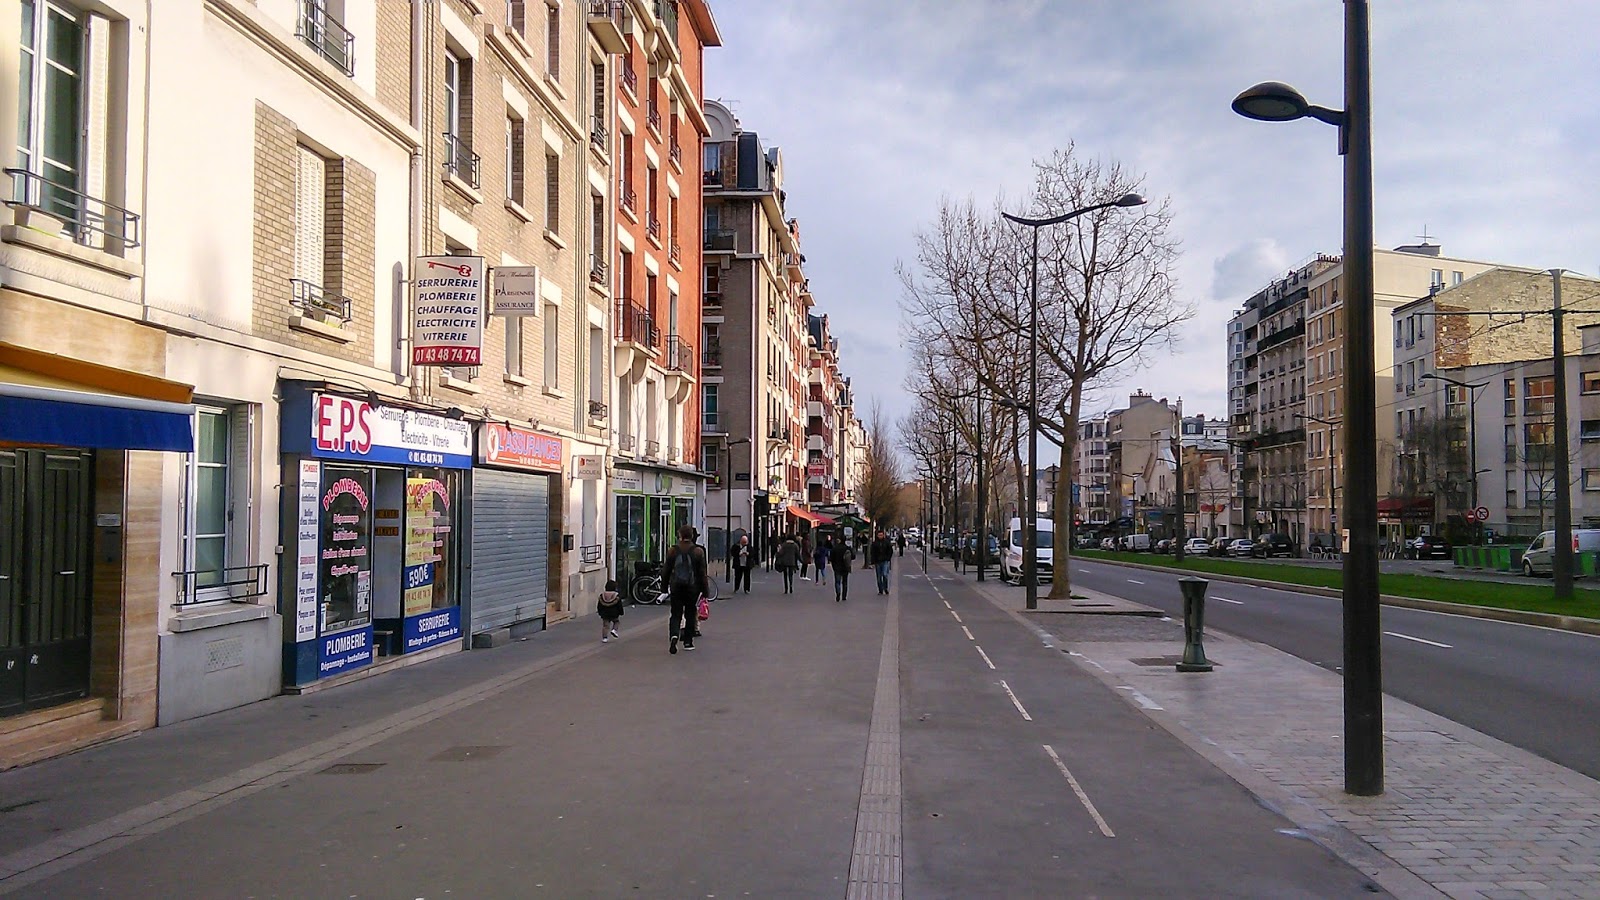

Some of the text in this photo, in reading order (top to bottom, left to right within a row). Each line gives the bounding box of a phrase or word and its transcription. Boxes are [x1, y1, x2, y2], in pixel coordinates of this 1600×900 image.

[418, 279, 478, 288] SERRURERIE
[419, 292, 477, 301] PLOMBERIE
[417, 306, 478, 315] CHAUFFAGE
[416, 319, 477, 328] ELECTRICITE
[422, 332, 468, 341] VITRERIE
[415, 349, 477, 361] 01 43 48 74 74
[318, 396, 371, 453] E.P.S
[414, 411, 440, 428] Plomberie
[432, 433, 450, 449] Vitrerie
[413, 451, 420, 463] 01
[323, 477, 369, 512] PLOMBERIE
[333, 514, 359, 525] Dépannage
[409, 564, 429, 588] 590€
[419, 613, 450, 632] SERRURERIE
[326, 633, 366, 656] PLOMBERIE
[321, 652, 369, 671] Dépannage Installation
